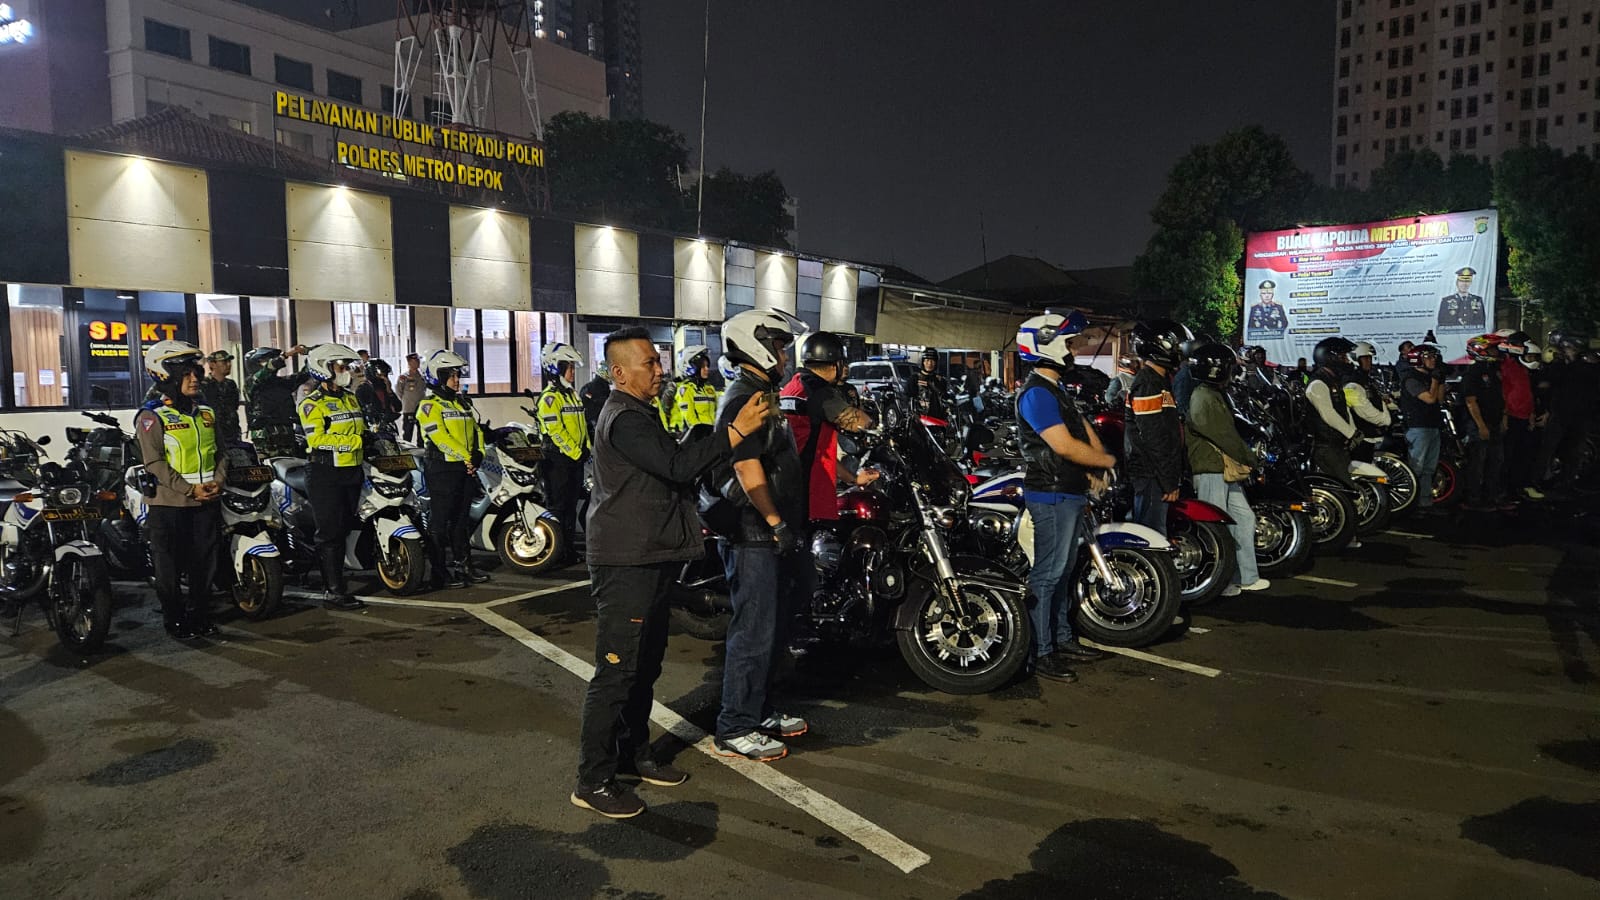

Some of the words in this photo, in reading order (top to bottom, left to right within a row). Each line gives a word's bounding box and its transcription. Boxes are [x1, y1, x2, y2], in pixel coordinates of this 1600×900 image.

[276, 90, 377, 135] PELAYANAN
[383, 114, 436, 147] PUBLIK
[441, 127, 504, 160] TERPADU
[507, 142, 544, 168] POLRI
[337, 141, 399, 174] POLRES
[403, 154, 454, 183] METRO
[458, 164, 503, 191] DEPOK
[1370, 225, 1416, 243] METRO
[1419, 221, 1449, 239] JAYA
